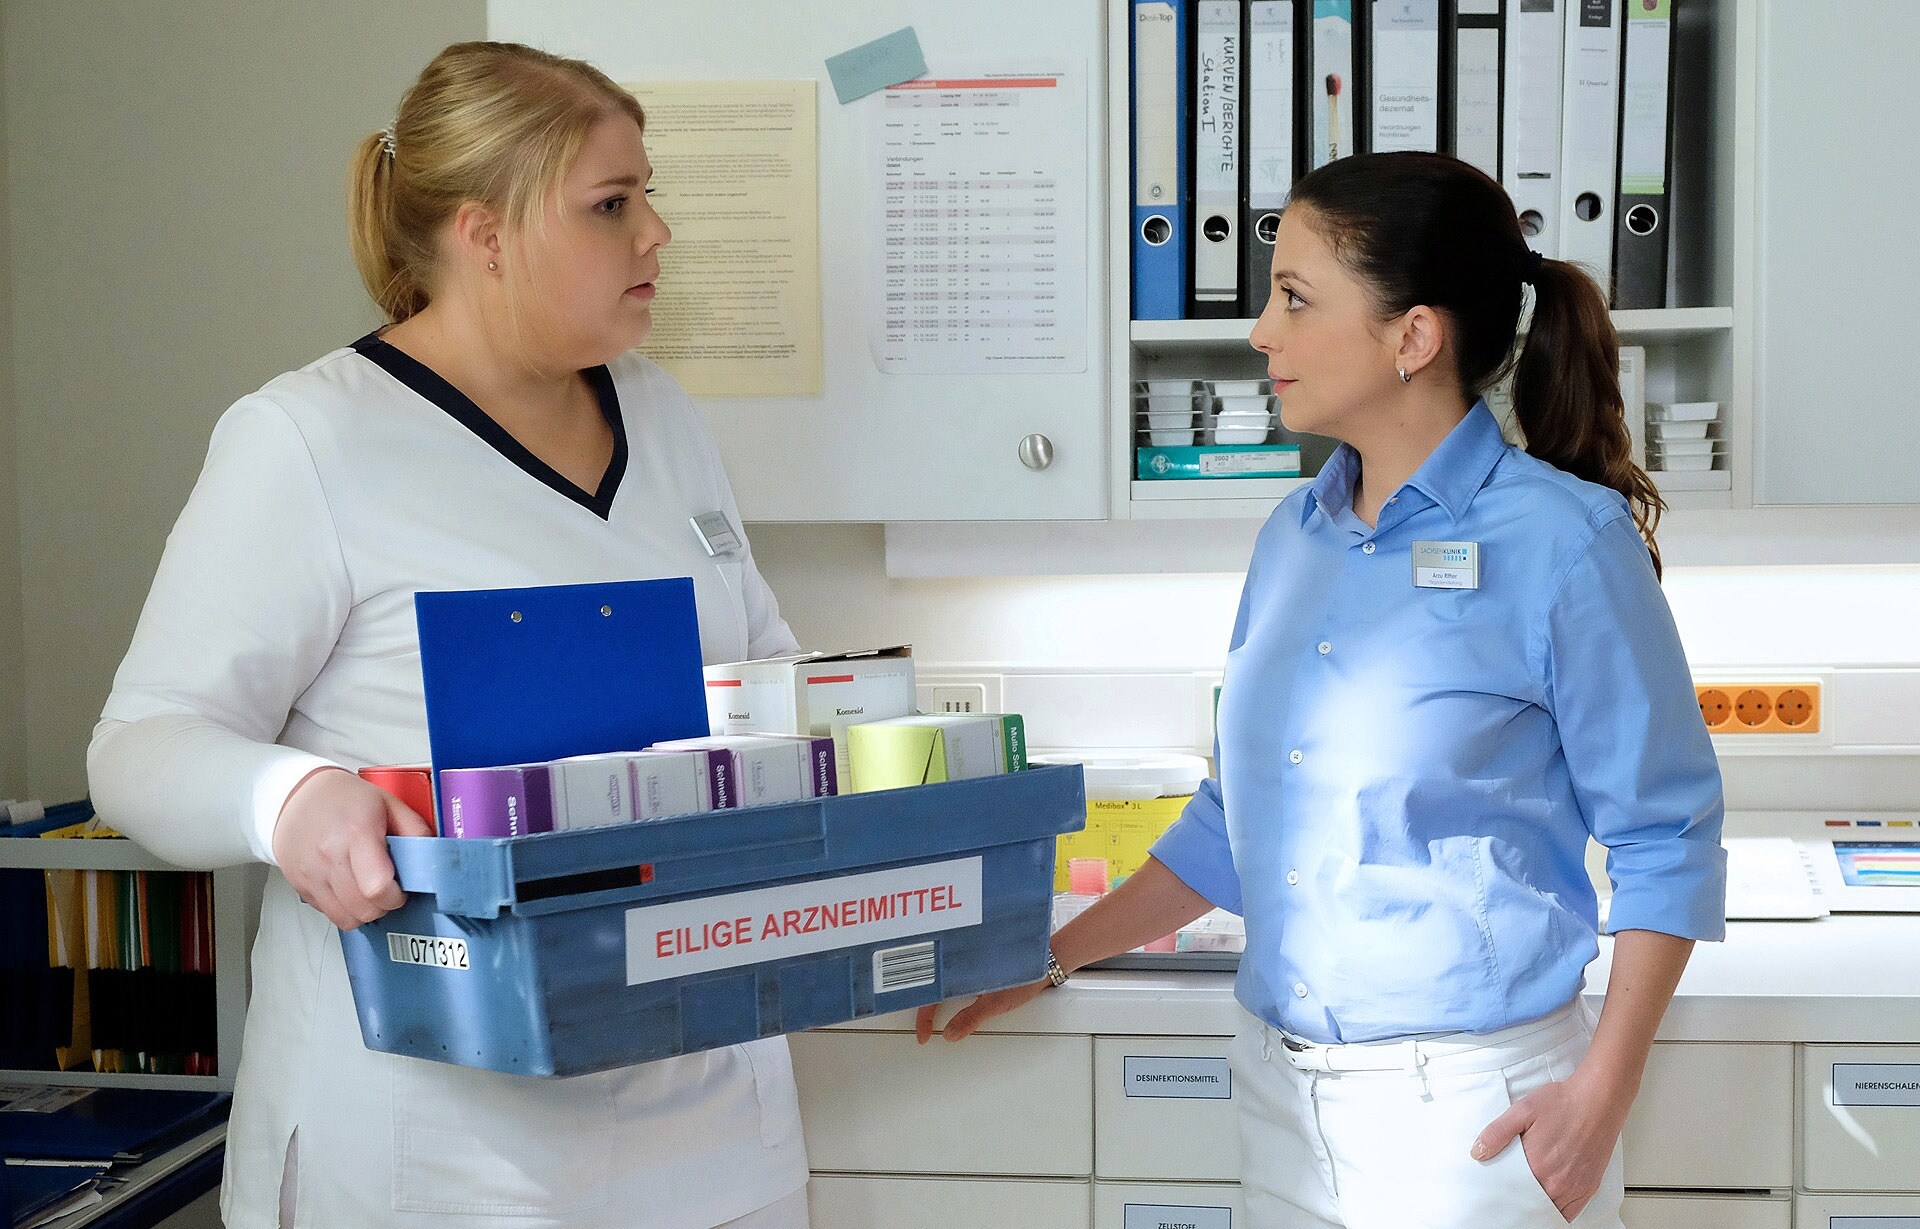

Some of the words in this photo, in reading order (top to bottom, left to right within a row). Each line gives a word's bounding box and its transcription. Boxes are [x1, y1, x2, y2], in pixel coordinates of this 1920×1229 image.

[1202, 52, 1216, 115] Station
[886, 155, 924, 163] Verbindungen
[728, 712, 750, 720] Komesid
[836, 706, 864, 716] Komesid
[1010, 726, 1019, 753] Mullo
[656, 916, 753, 958] EILIGE
[761, 884, 962, 941] ARZNEIMITTEL
[410, 937, 467, 967] 071312
[1136, 1074, 1219, 1083] DESINFEKTIONSMITTEL
